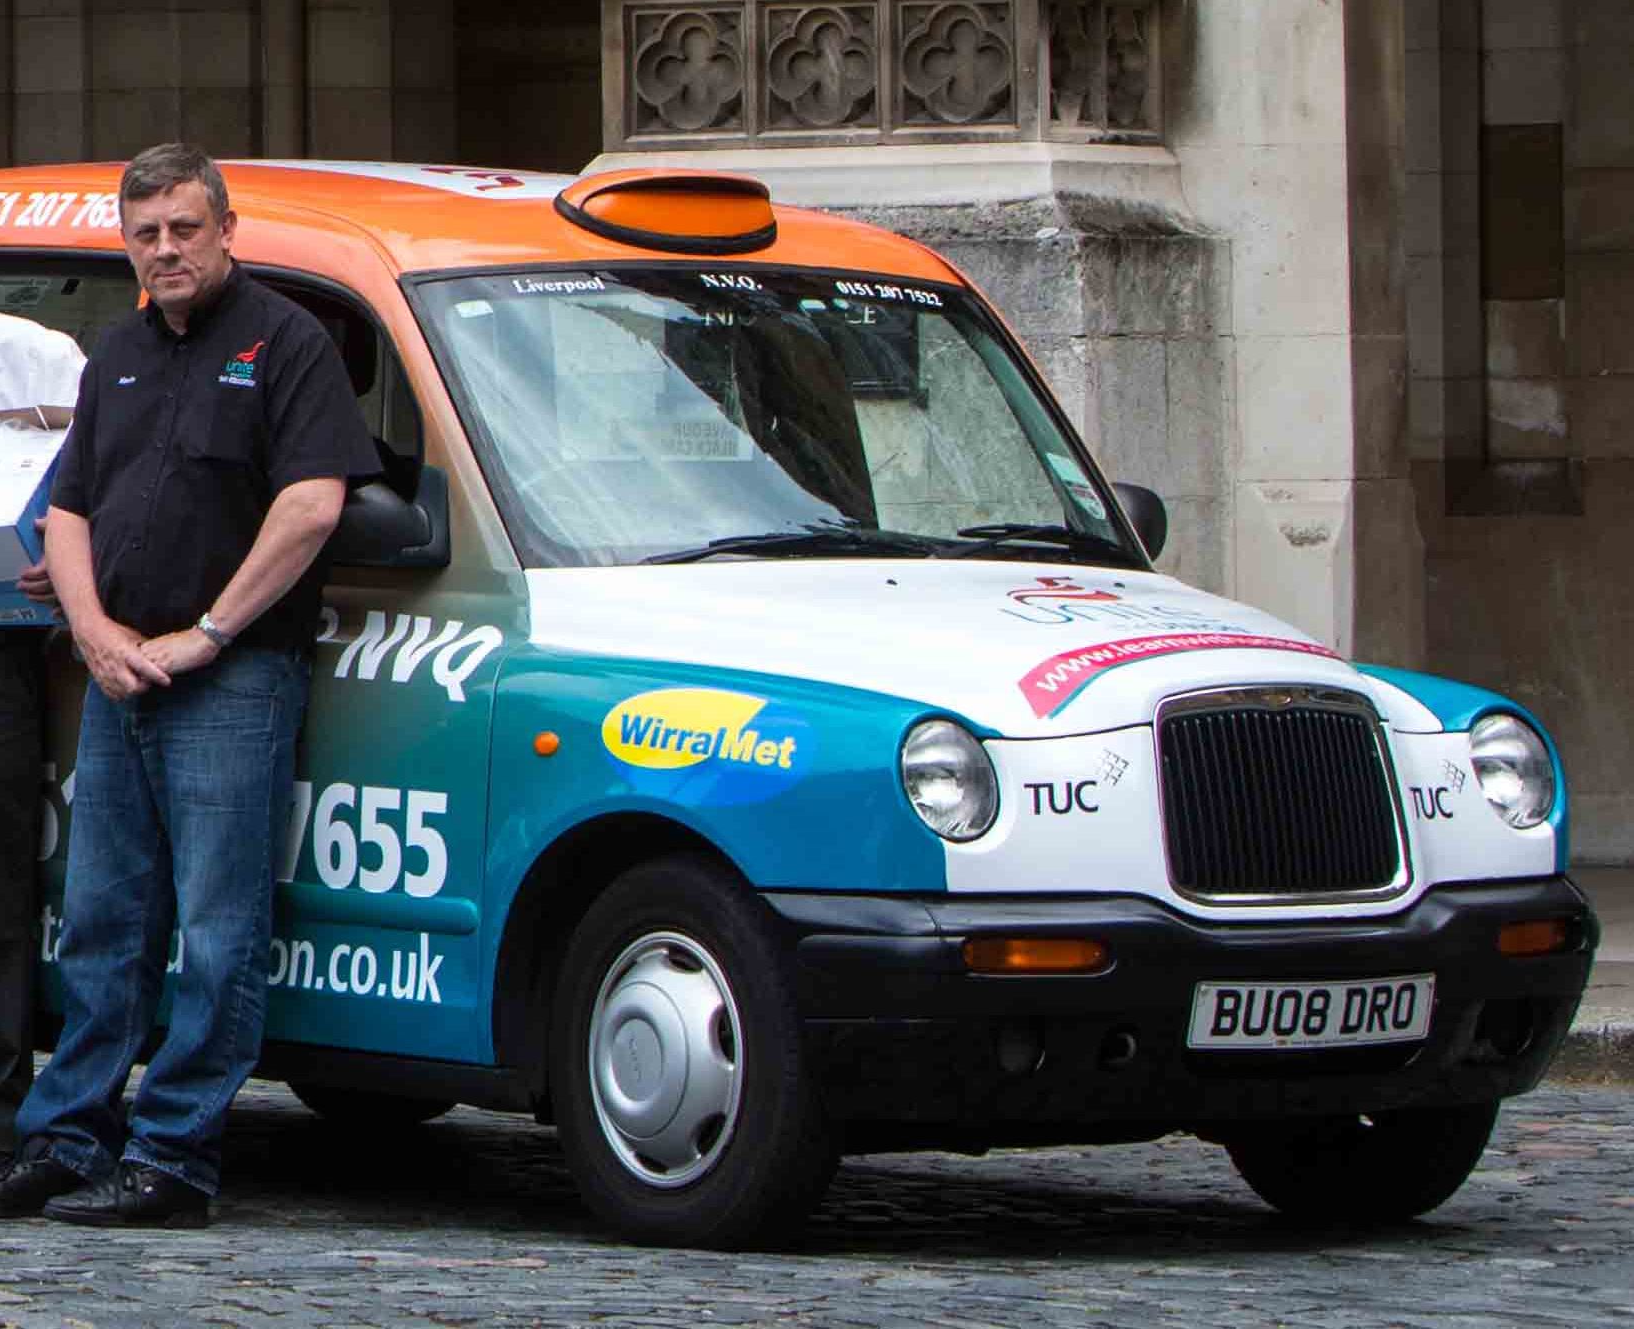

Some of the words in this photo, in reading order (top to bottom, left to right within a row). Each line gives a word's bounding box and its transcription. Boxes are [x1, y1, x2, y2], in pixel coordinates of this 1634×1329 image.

[13, 192, 78, 228] 207
[512, 276, 605, 293] Liverpool
[699, 273, 762, 291] N.V.Q.
[836, 281, 875, 297] 0151
[334, 611, 503, 702] NVQ
[1023, 780, 1099, 815] TUC
[1409, 787, 1454, 819] TUC
[1209, 988, 1332, 1037] BU08
